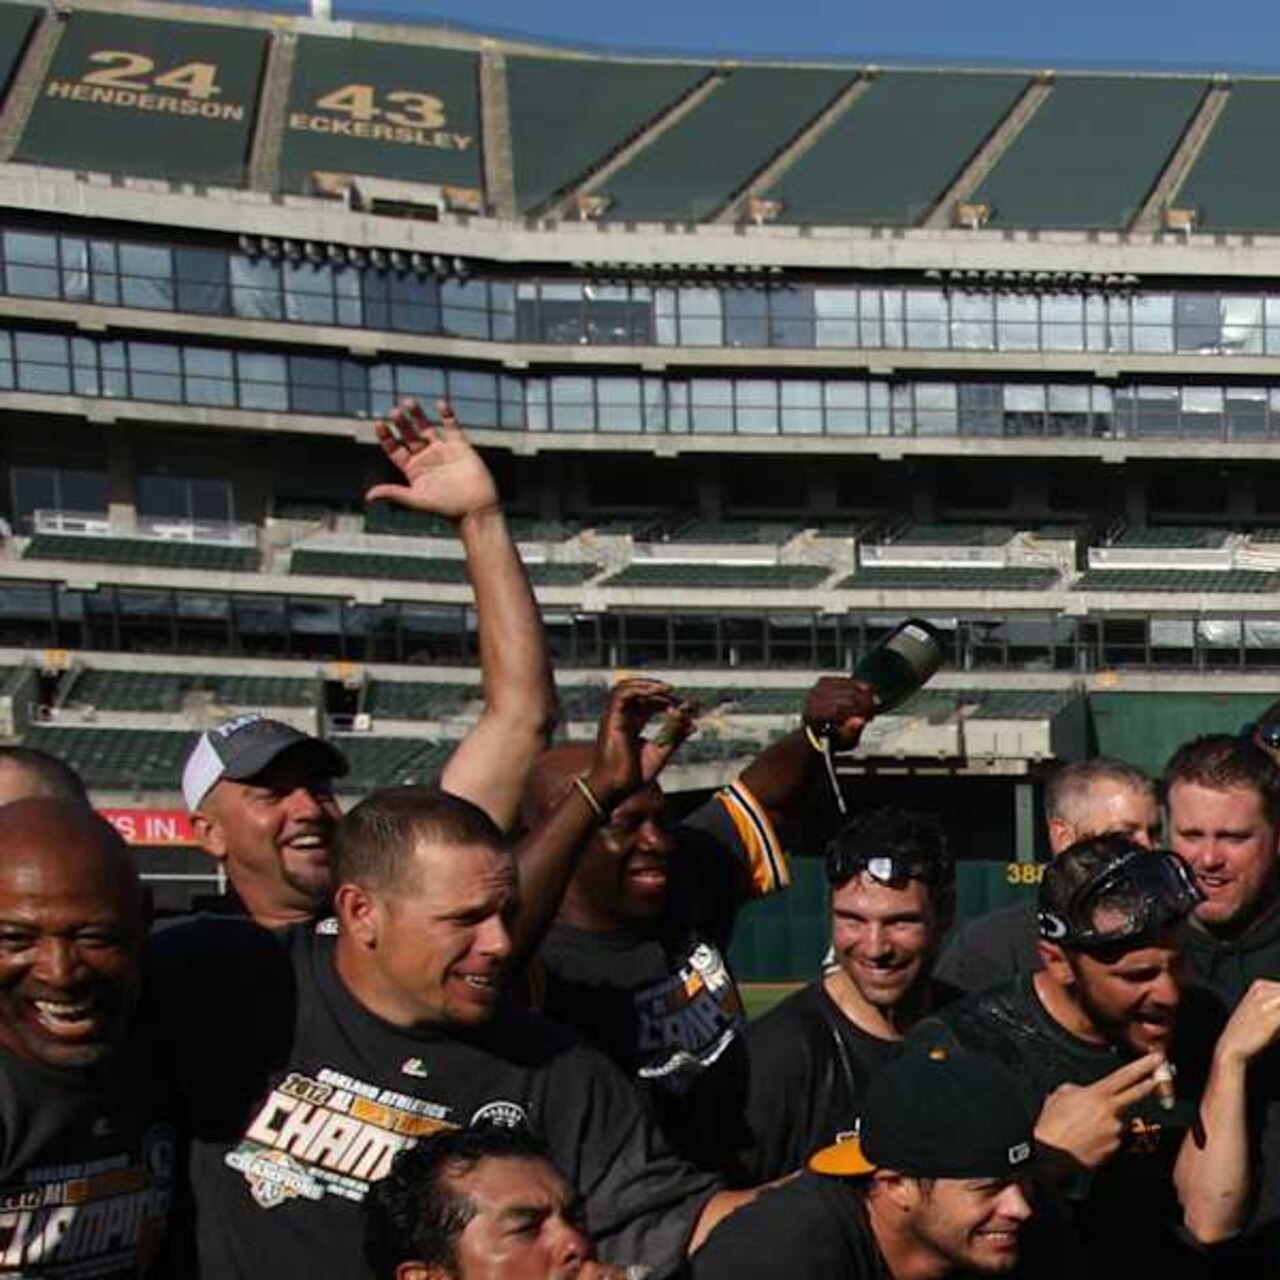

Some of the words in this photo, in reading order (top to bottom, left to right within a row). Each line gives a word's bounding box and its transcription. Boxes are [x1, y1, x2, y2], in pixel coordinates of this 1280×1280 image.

[81, 50, 221, 98] 24
[46, 82, 245, 121] HENDERSON
[316, 84, 447, 129] 43
[289, 113, 473, 151] ECKERSLEY
[277, 1071, 333, 1106] 2012
[327, 1089, 354, 1112] AL
